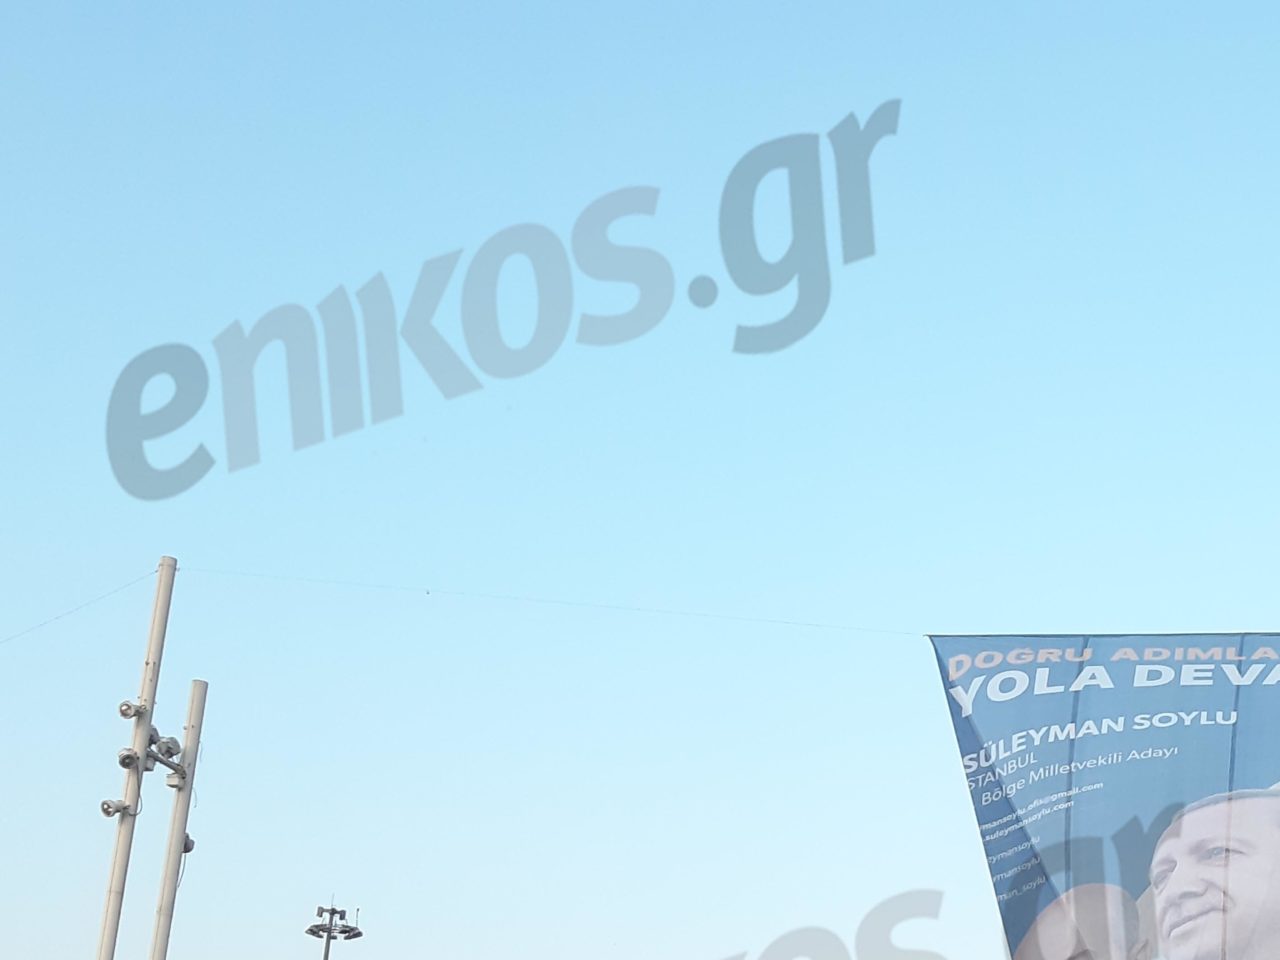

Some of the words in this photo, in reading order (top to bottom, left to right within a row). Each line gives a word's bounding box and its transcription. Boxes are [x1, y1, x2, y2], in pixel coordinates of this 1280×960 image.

[949, 664, 1115, 718] YOLA
[962, 716, 1125, 774] SÜLEYMAN
[1132, 710, 1238, 730] SOYLU
[1028, 751, 1123, 785] Milletvekili
